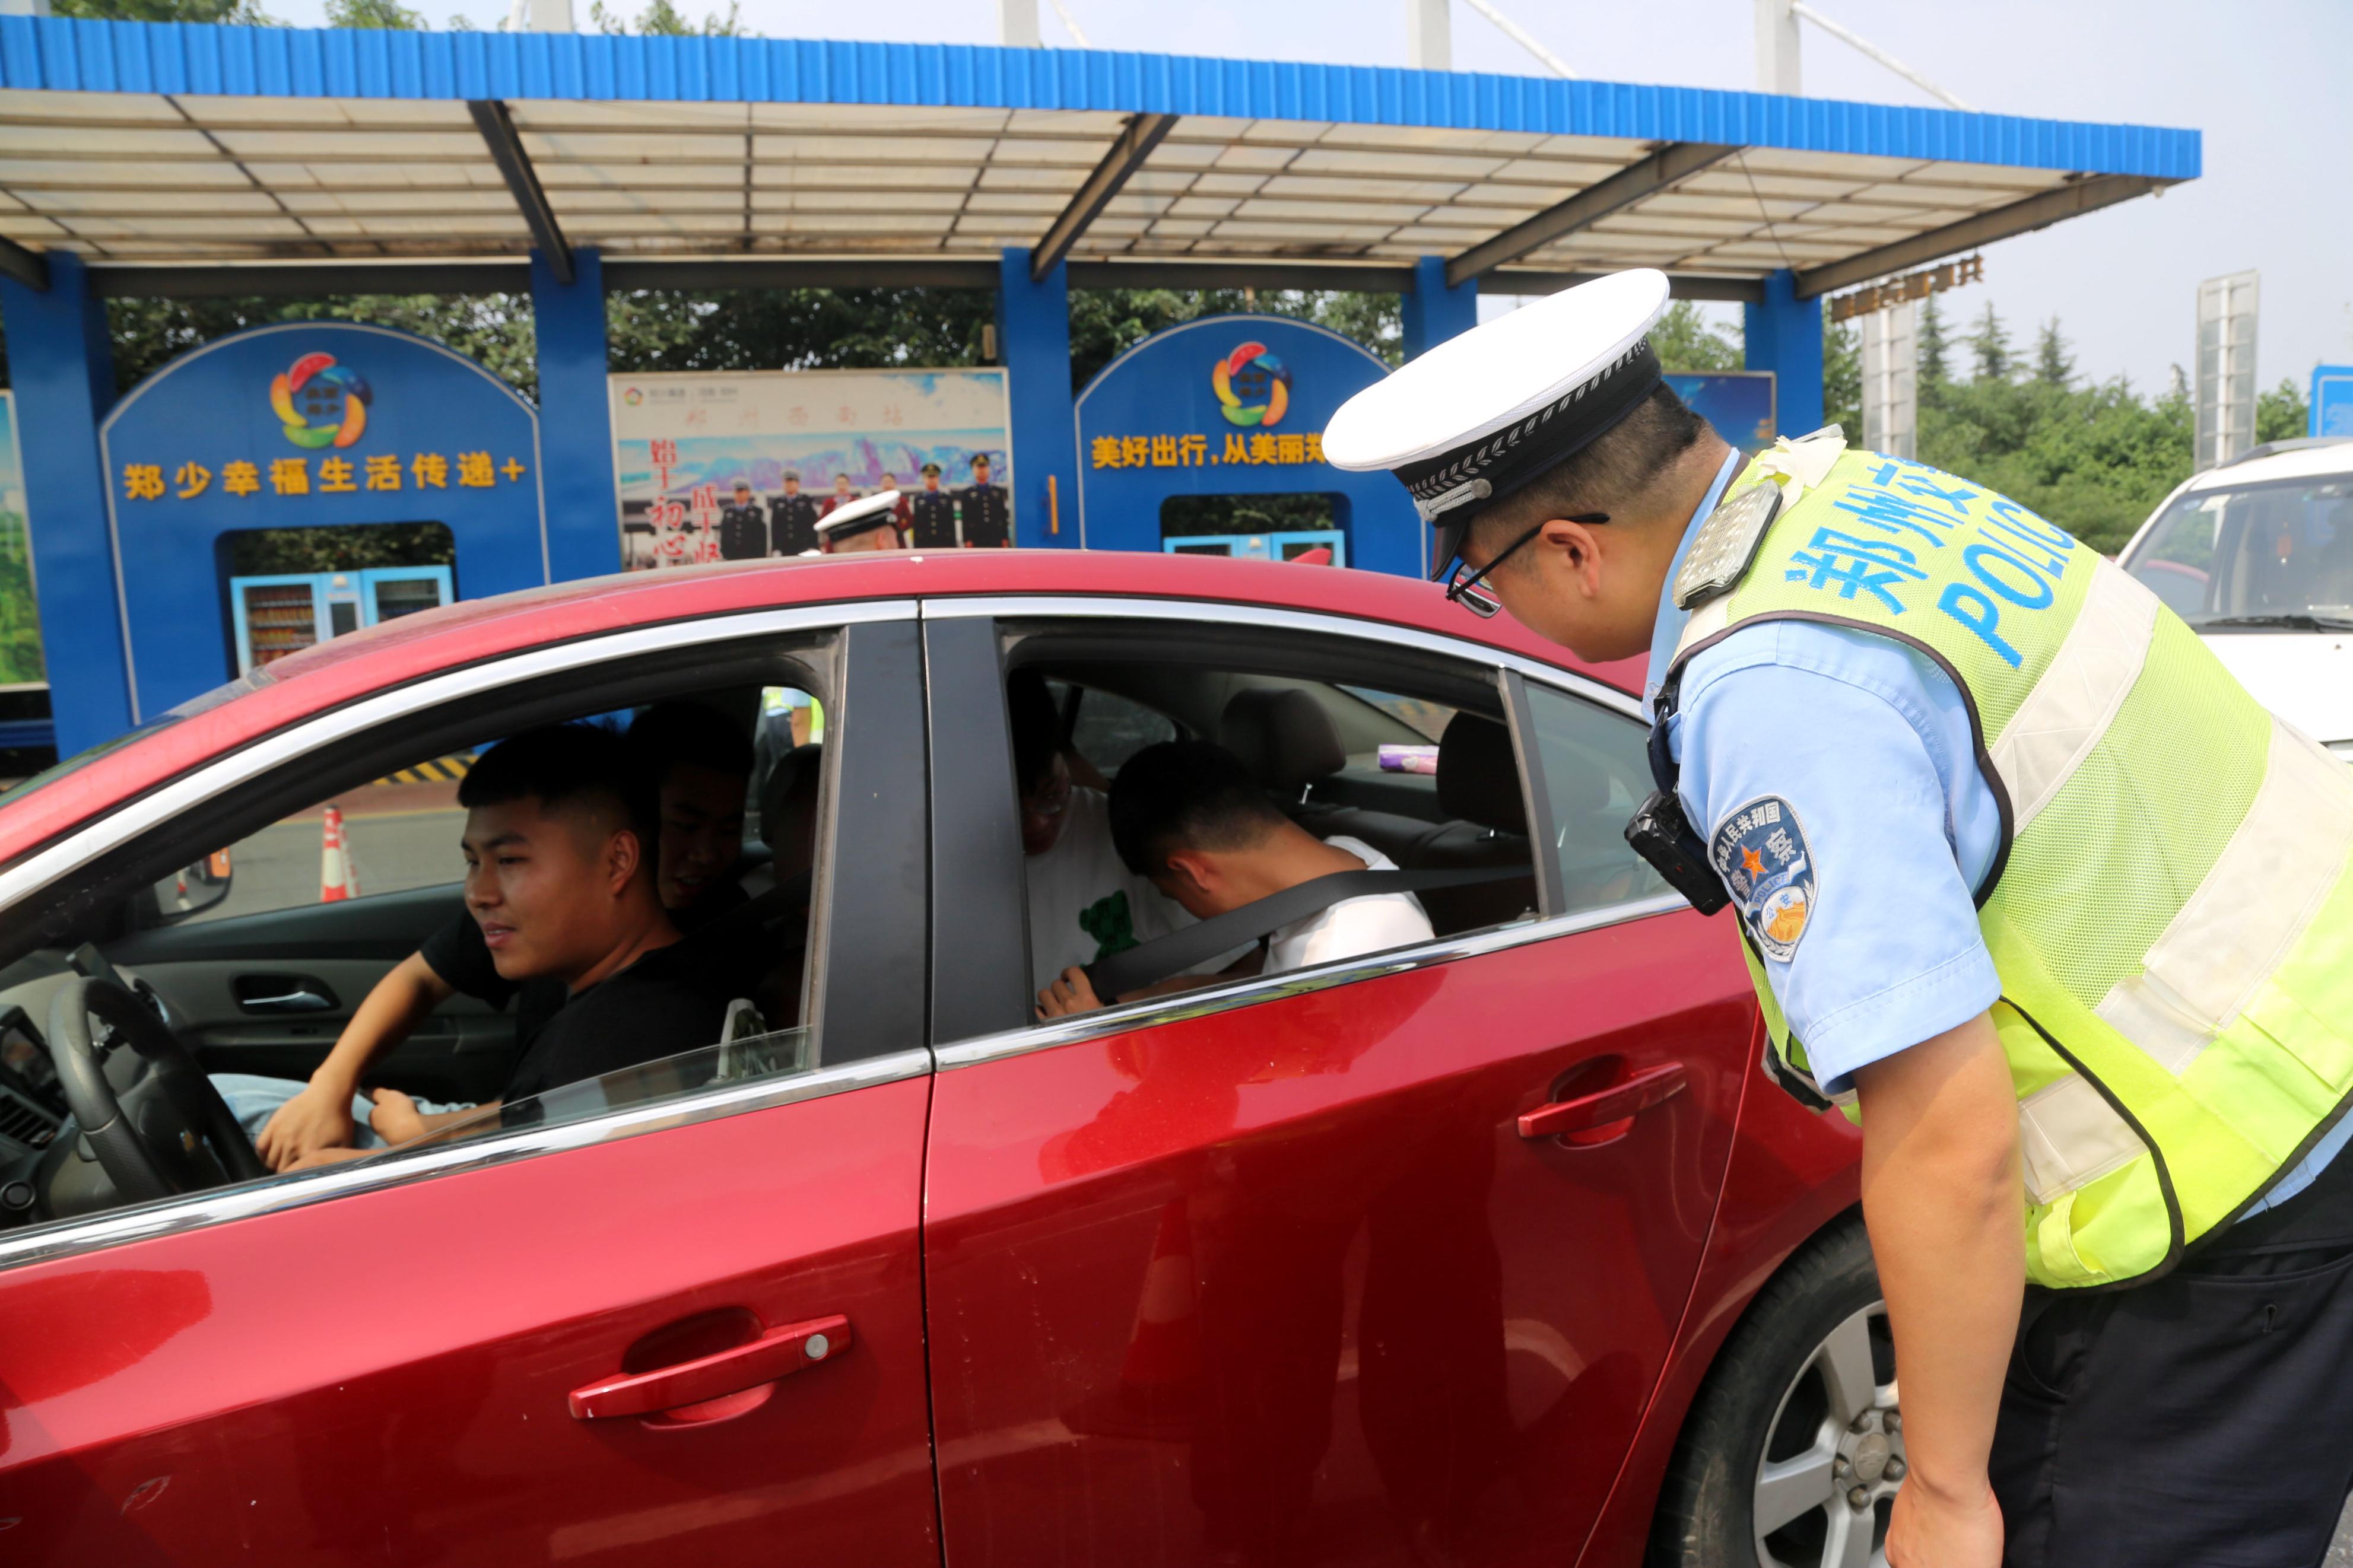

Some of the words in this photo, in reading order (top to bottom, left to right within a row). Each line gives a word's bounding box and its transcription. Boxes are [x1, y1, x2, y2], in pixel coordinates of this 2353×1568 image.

[649, 438, 686, 556] 始于初心
[1784, 452, 1985, 615] 郑州交
[1937, 493, 2075, 669] POLIC
[1717, 801, 1781, 873] 中华人民共和国
[1754, 872, 1789, 904] POLICE
[1766, 893, 1792, 918] 公安
